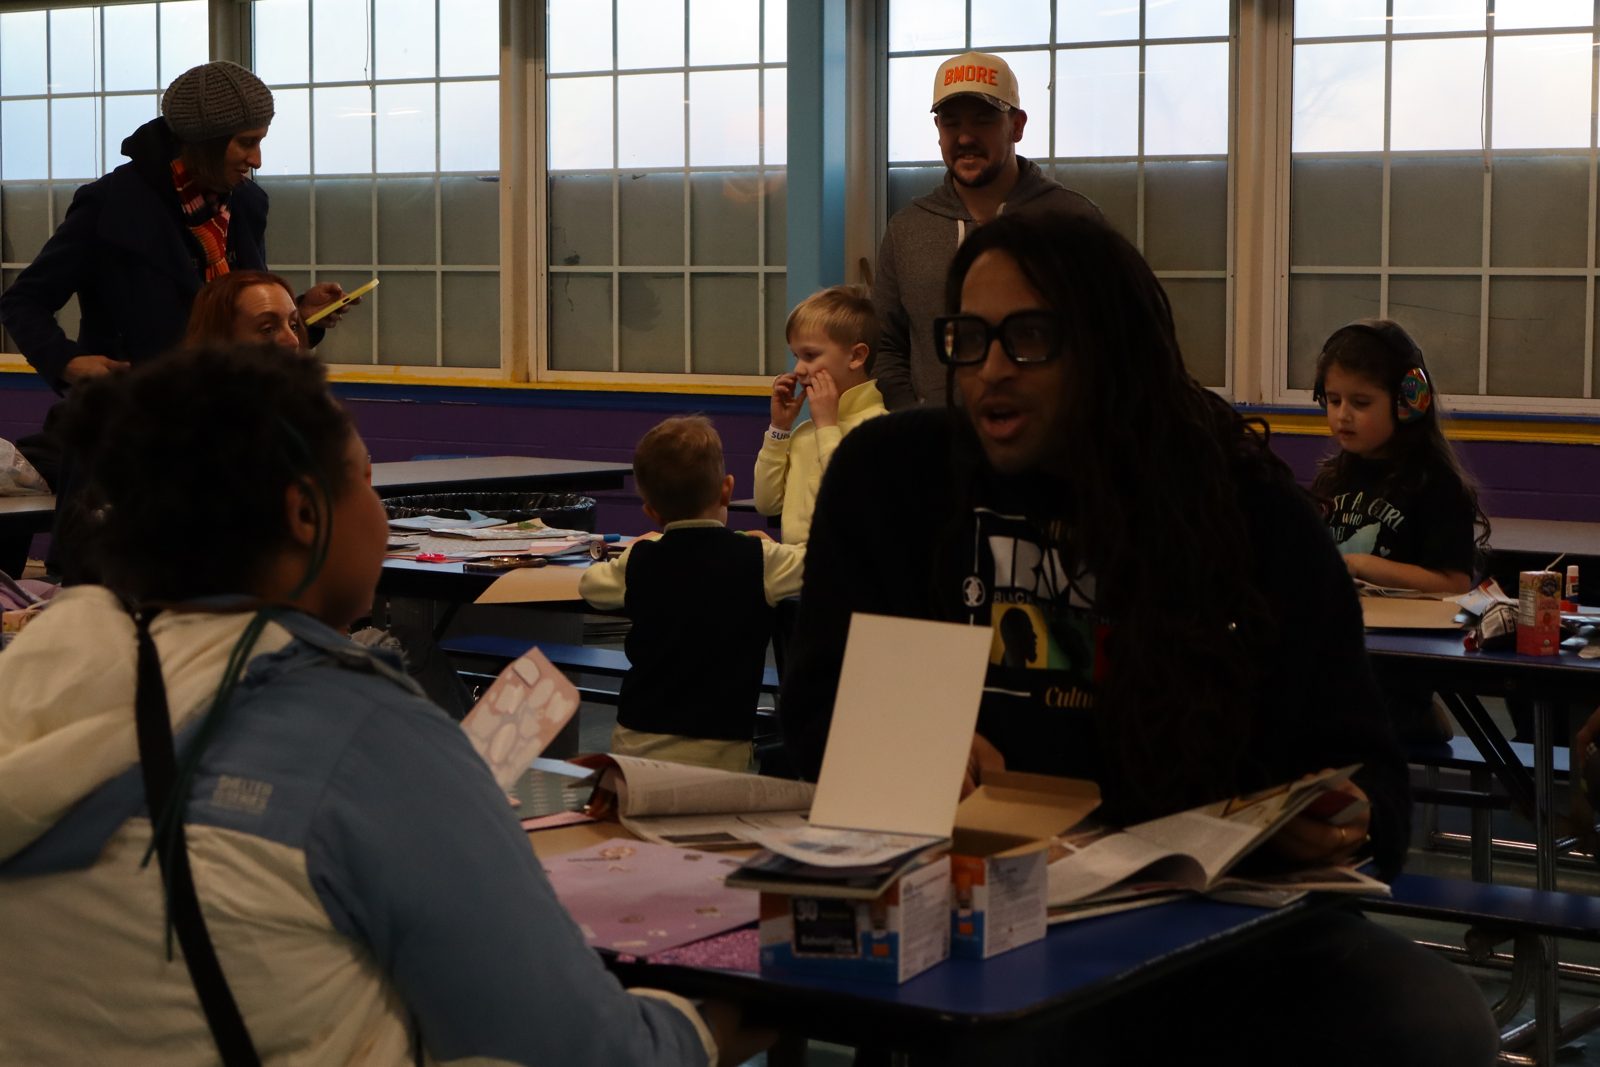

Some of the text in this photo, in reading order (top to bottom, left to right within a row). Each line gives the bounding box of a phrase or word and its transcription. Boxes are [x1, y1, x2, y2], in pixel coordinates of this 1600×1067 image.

[944, 65, 998, 86] BMORE
[1342, 511, 1363, 526] WHO
[1351, 491, 1364, 512] A
[1367, 498, 1405, 534] GIRL
